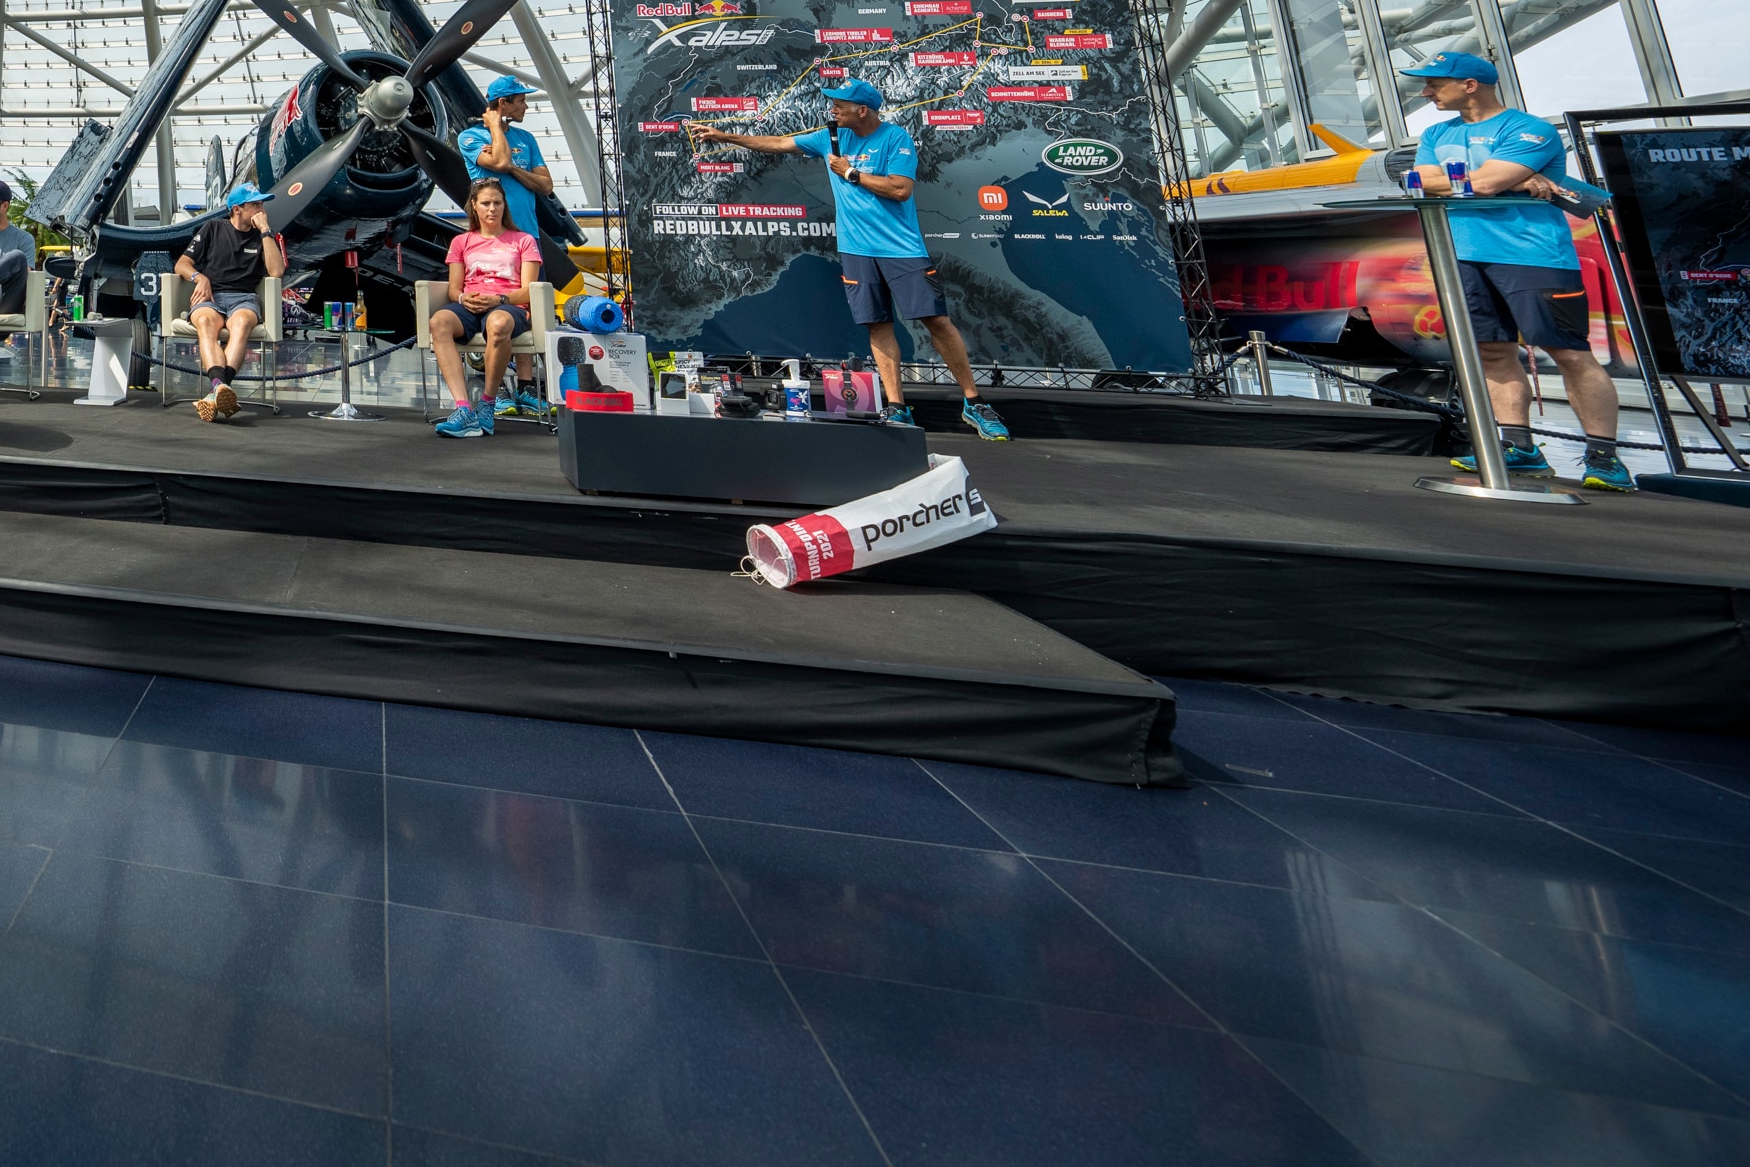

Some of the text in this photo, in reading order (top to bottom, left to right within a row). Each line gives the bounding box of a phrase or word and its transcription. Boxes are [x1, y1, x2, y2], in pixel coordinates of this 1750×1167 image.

[636, 1, 692, 17] Red Bull
[858, 7, 887, 15] GERMANY
[1058, 146, 1095, 156] LAND
[1648, 147, 1728, 163] ROUTE
[1063, 156, 1109, 166] ROVER
[655, 205, 716, 215] FOLLOW ON
[722, 206, 803, 216] LIVE TRACKING
[1031, 209, 1069, 217] SALEWA
[1083, 202, 1133, 211] SUUNTO
[653, 220, 837, 237] REDBULLXALPS.COM
[1256, 260, 1361, 312] Bull
[861, 493, 963, 551] porcher
[787, 518, 821, 580] TURNPOINT
[812, 530, 834, 560] 2021
